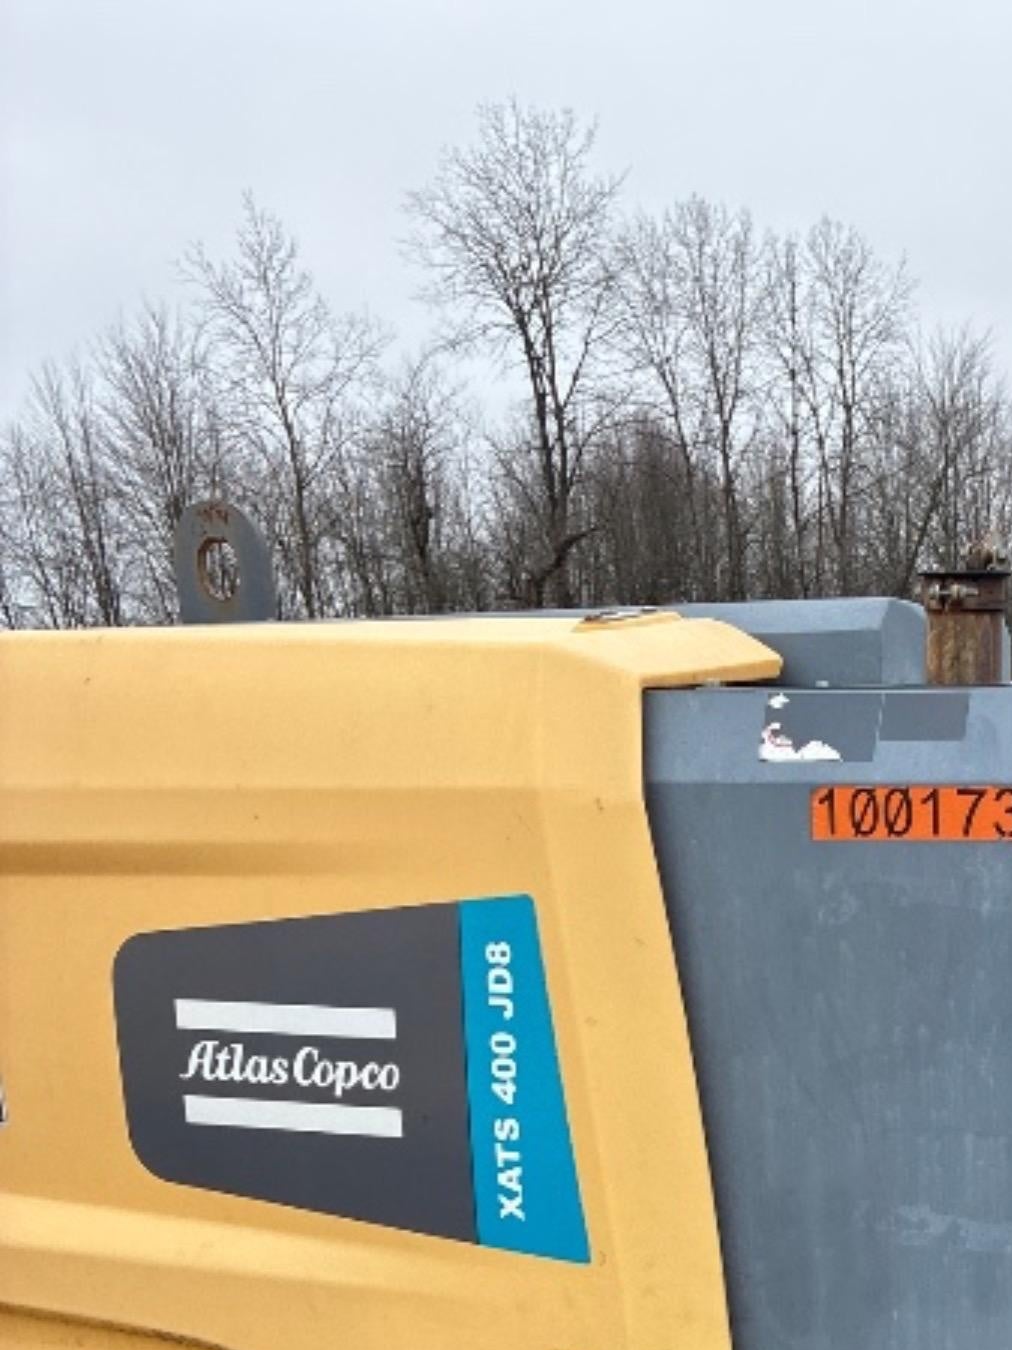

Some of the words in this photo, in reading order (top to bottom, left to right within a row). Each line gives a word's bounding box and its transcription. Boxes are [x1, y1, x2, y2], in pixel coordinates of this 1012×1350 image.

[484, 940, 514, 1021] JD8
[179, 1039, 290, 1085] Atlas
[293, 1046, 400, 1099] Copco
[489, 1031, 517, 1105] 400
[494, 1117, 526, 1222] XATS
